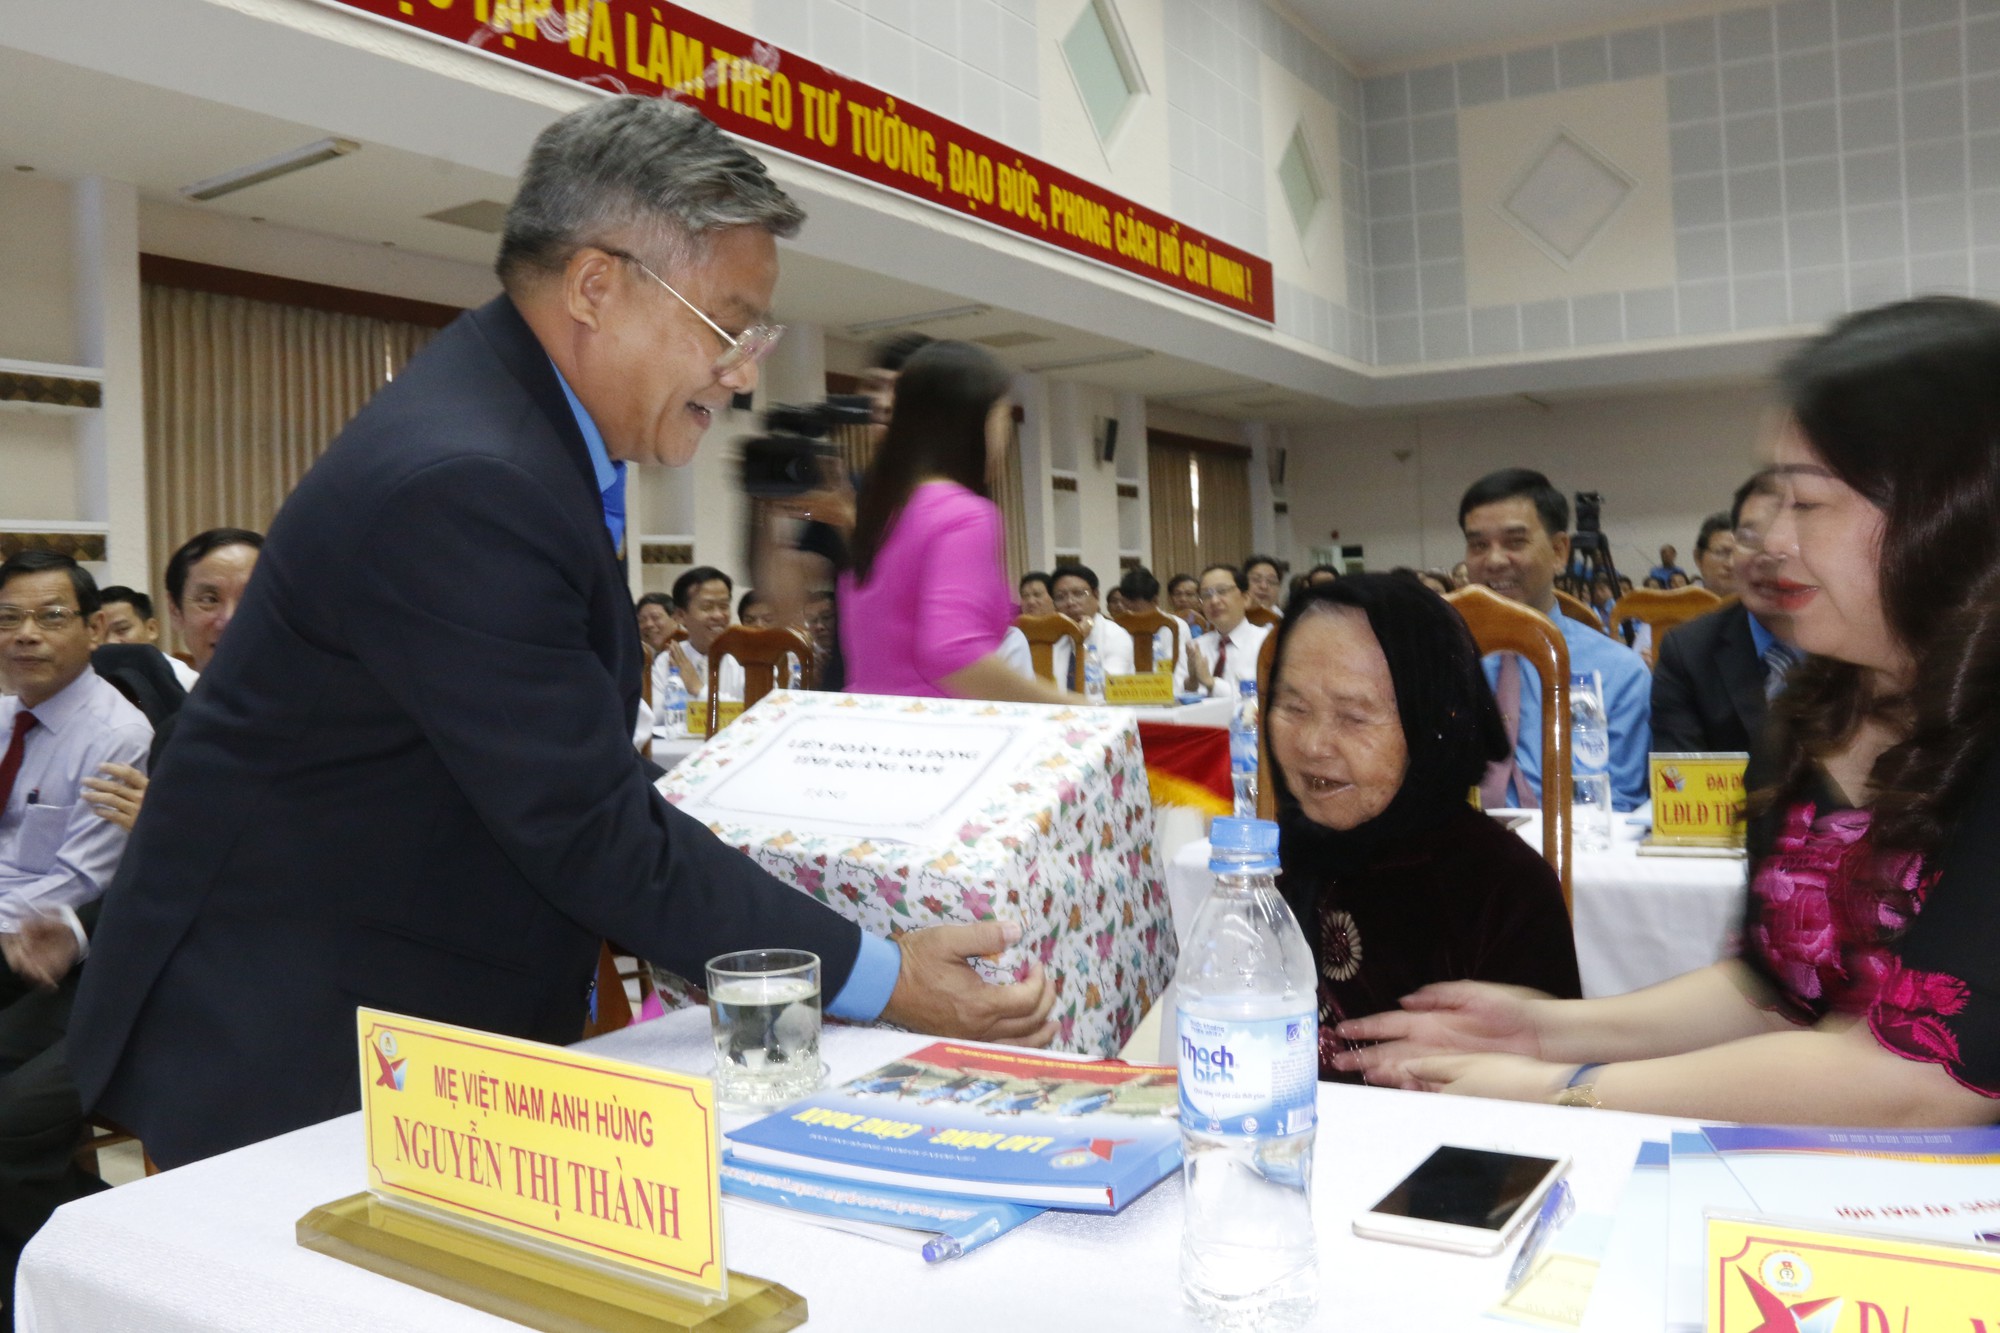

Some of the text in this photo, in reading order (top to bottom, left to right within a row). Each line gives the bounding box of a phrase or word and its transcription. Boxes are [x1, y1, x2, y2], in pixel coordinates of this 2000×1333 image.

[625, 6, 705, 100] LÀM
[711, 47, 792, 131] THEO
[799, 81, 841, 147] TƯ
[847, 96, 943, 193] TƯỞNG,
[948, 141, 994, 211] ĐẠO
[997, 158, 1047, 231] ĐỨC,
[1050, 184, 1112, 250] PHONG
[1114, 207, 1158, 268] CÁCH
[1159, 222, 1181, 277] HỒ
[1183, 240, 1208, 288] CHÍ
[1209, 252, 1245, 301] MINH
[433, 1065, 655, 1148] MẸ VIỆT NAM ANH HÙNG
[393, 1115, 503, 1192] NGUYỄN
[509, 1146, 563, 1222] THỊ
[567, 1156, 683, 1241] THÀNH
